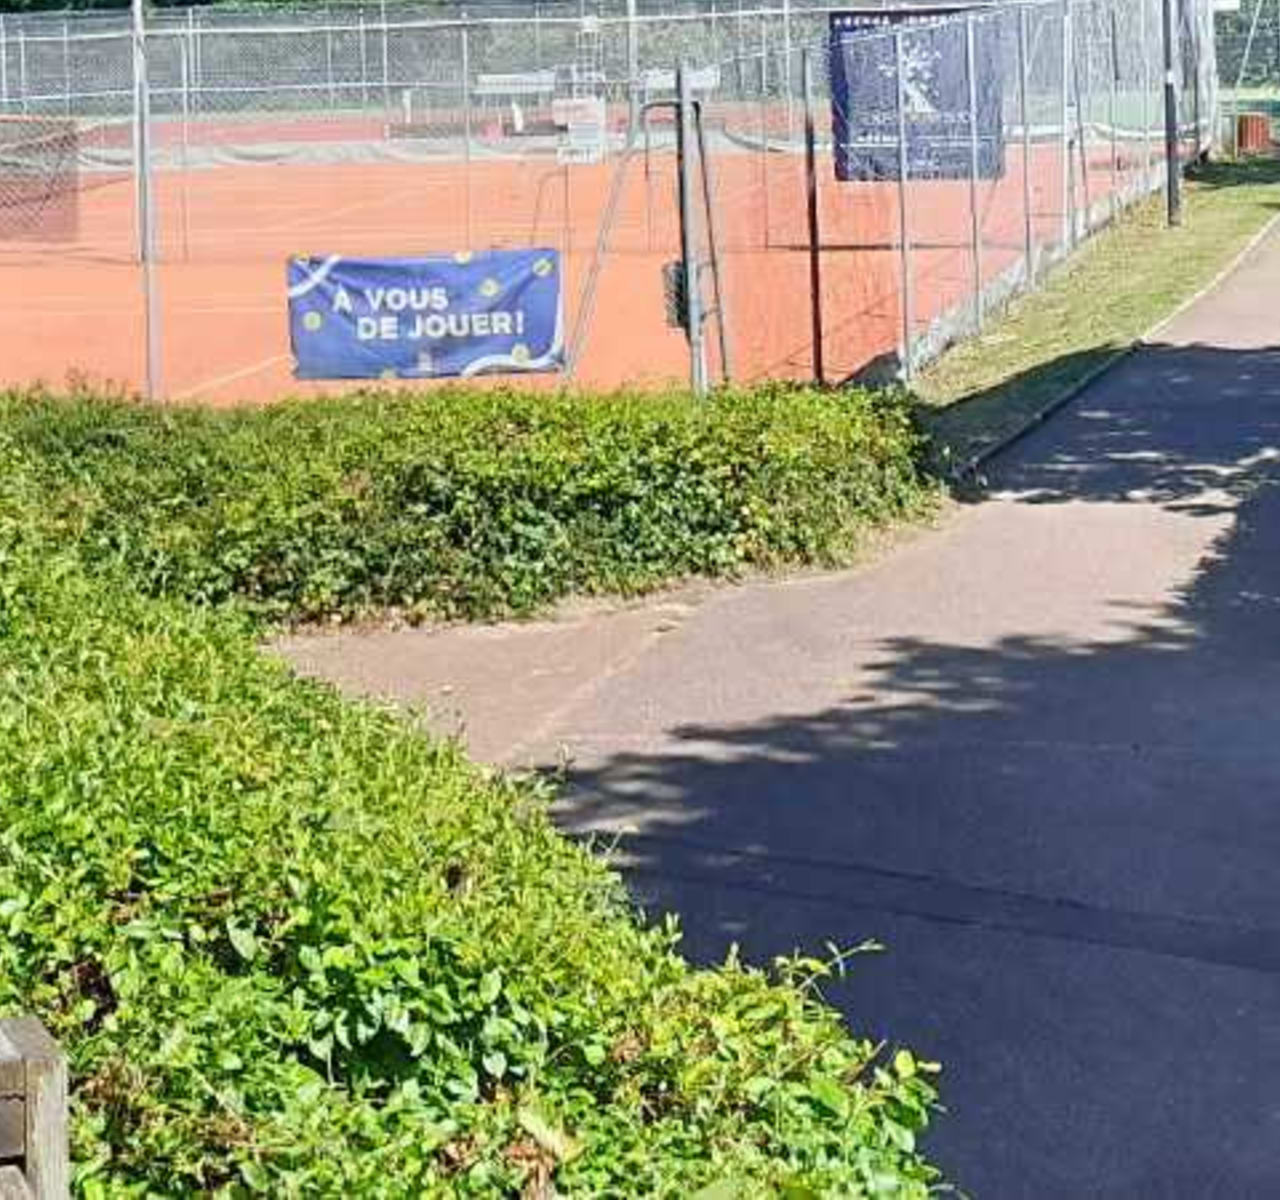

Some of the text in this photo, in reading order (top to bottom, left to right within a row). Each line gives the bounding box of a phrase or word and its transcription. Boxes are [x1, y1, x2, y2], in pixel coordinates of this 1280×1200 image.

[365, 286, 449, 312] VOUS
[357, 311, 524, 341] DE JOUER!
